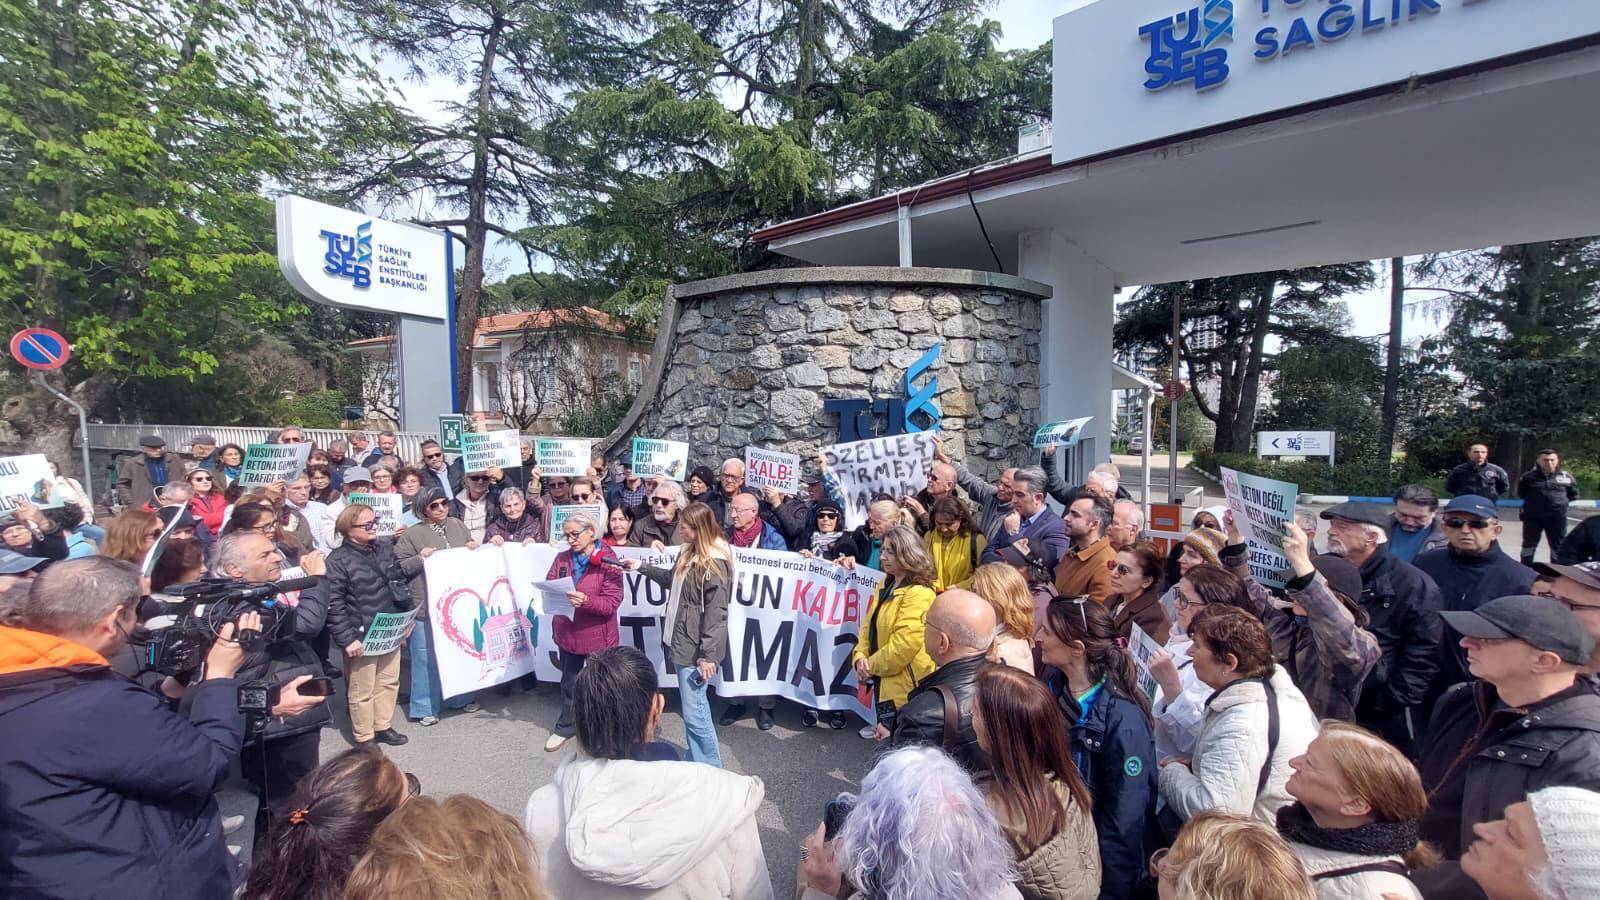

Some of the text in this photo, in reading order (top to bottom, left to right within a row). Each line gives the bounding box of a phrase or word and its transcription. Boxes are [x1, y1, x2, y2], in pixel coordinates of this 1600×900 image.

[1143, 47, 1231, 91] SEB
[378, 244, 412, 259] TÜRKİYE
[378, 255, 408, 268] SAĞLIK
[324, 252, 371, 288] SEB
[379, 265, 428, 281] ENSTİTÜLERİ
[379, 276, 427, 292] BAŞKANLIĞI
[635, 452, 652, 462] ARSA
[246, 460, 276, 471] BETONA
[750, 459, 793, 480] KALBİ
[834, 456, 932, 485] TİRMEYE
[1241, 484, 1261, 506] BETON
[1262, 490, 1288, 515] DEĞİL,
[648, 555, 668, 566] Eski
[735, 552, 781, 569] Hastanesi
[783, 562, 807, 574] arazi
